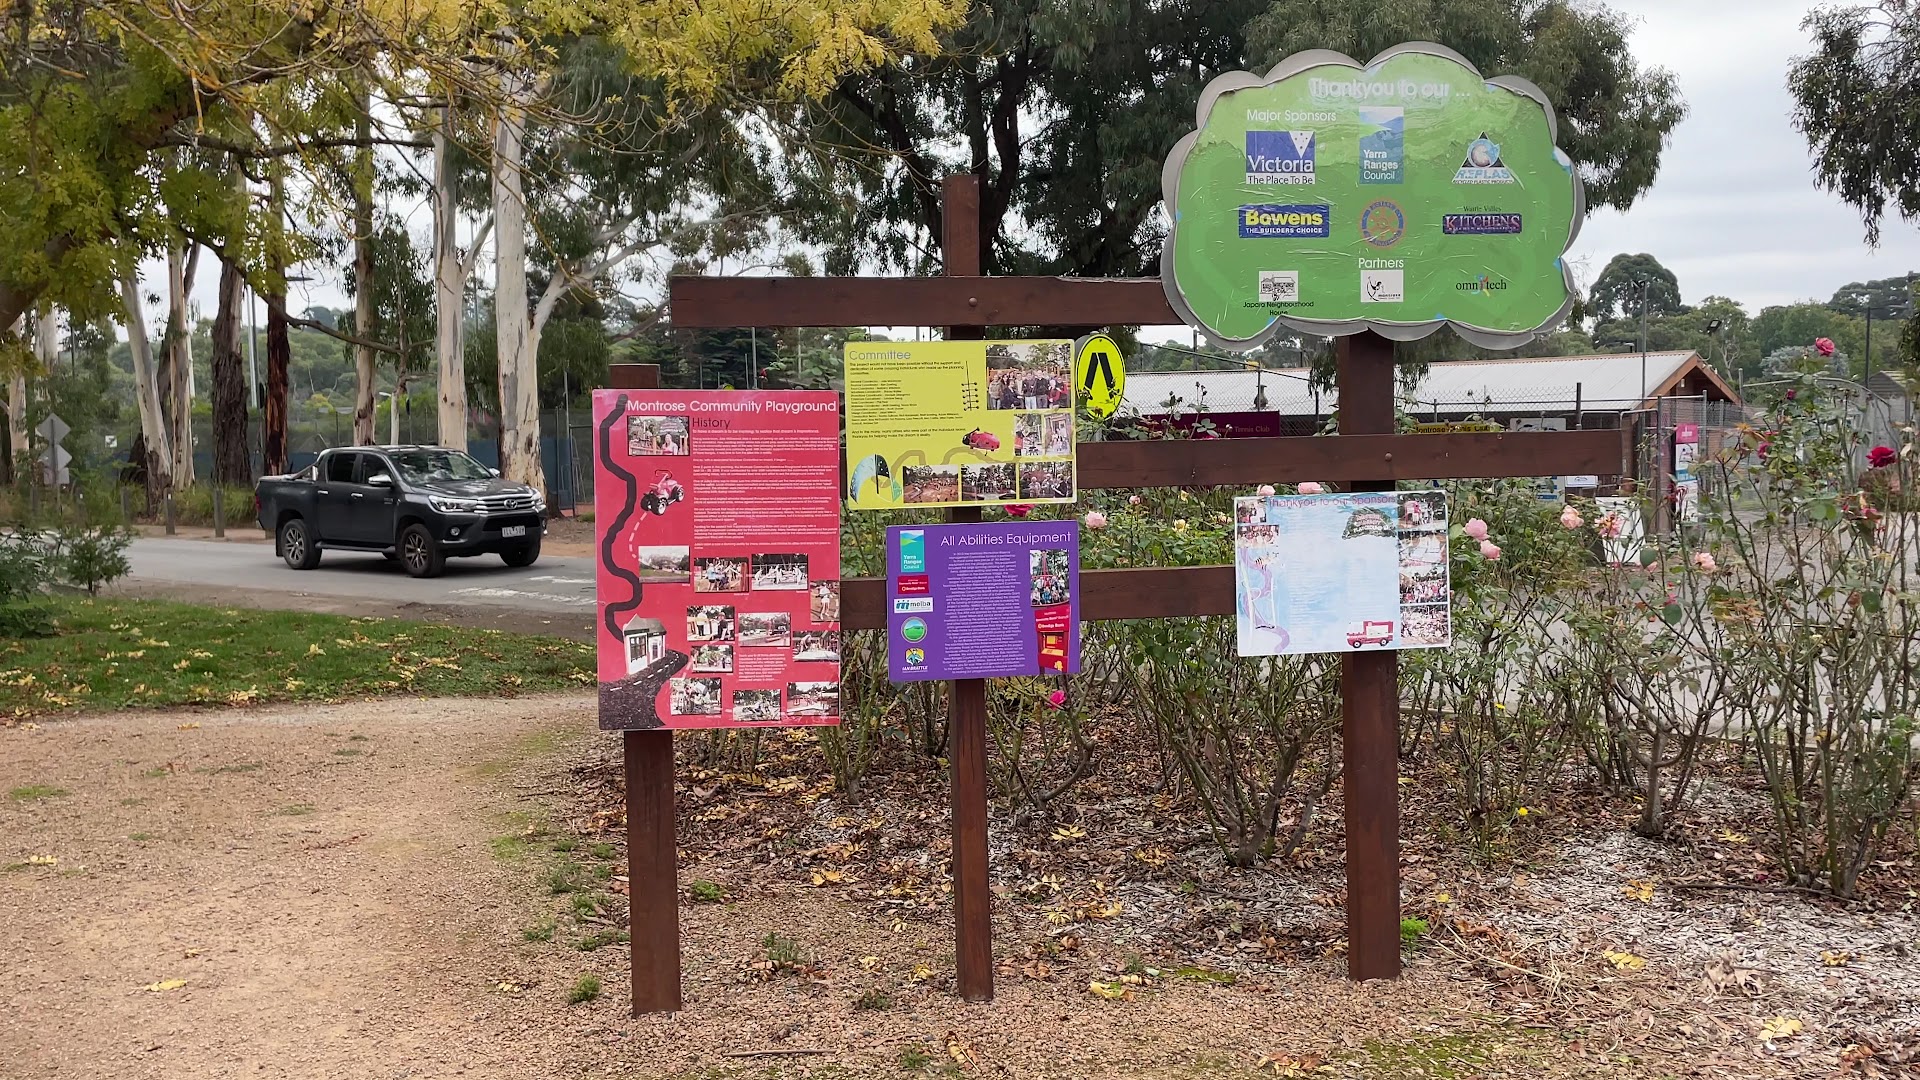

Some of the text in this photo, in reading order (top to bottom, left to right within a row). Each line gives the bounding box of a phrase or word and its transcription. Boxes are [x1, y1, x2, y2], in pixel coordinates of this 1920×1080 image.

[1310, 77, 1394, 99] Thankyou
[1398, 80, 1418, 98] to
[1422, 82, 1450, 98] our
[1247, 109, 1337, 122] Major Sponsors
[1363, 149, 1387, 159] Yarra
[1248, 155, 1314, 173] Victoria
[1363, 160, 1398, 170] Ranges
[1248, 175, 1313, 185] The Place To Be
[1363, 171, 1396, 180] Council
[1456, 169, 1510, 179] REPLAS
[1245, 209, 1323, 226] Bowens
[1444, 214, 1520, 232] KITCHENS
[1358, 257, 1404, 269] Partners
[1266, 300, 1315, 309] Neighbourhood
[849, 350, 911, 360] Committee
[627, 400, 837, 414] Montrose Community Playground
[692, 418, 731, 430] History
[1352, 496, 1396, 506] Sponsors
[940, 532, 1071, 547] All Abilities Equipment
